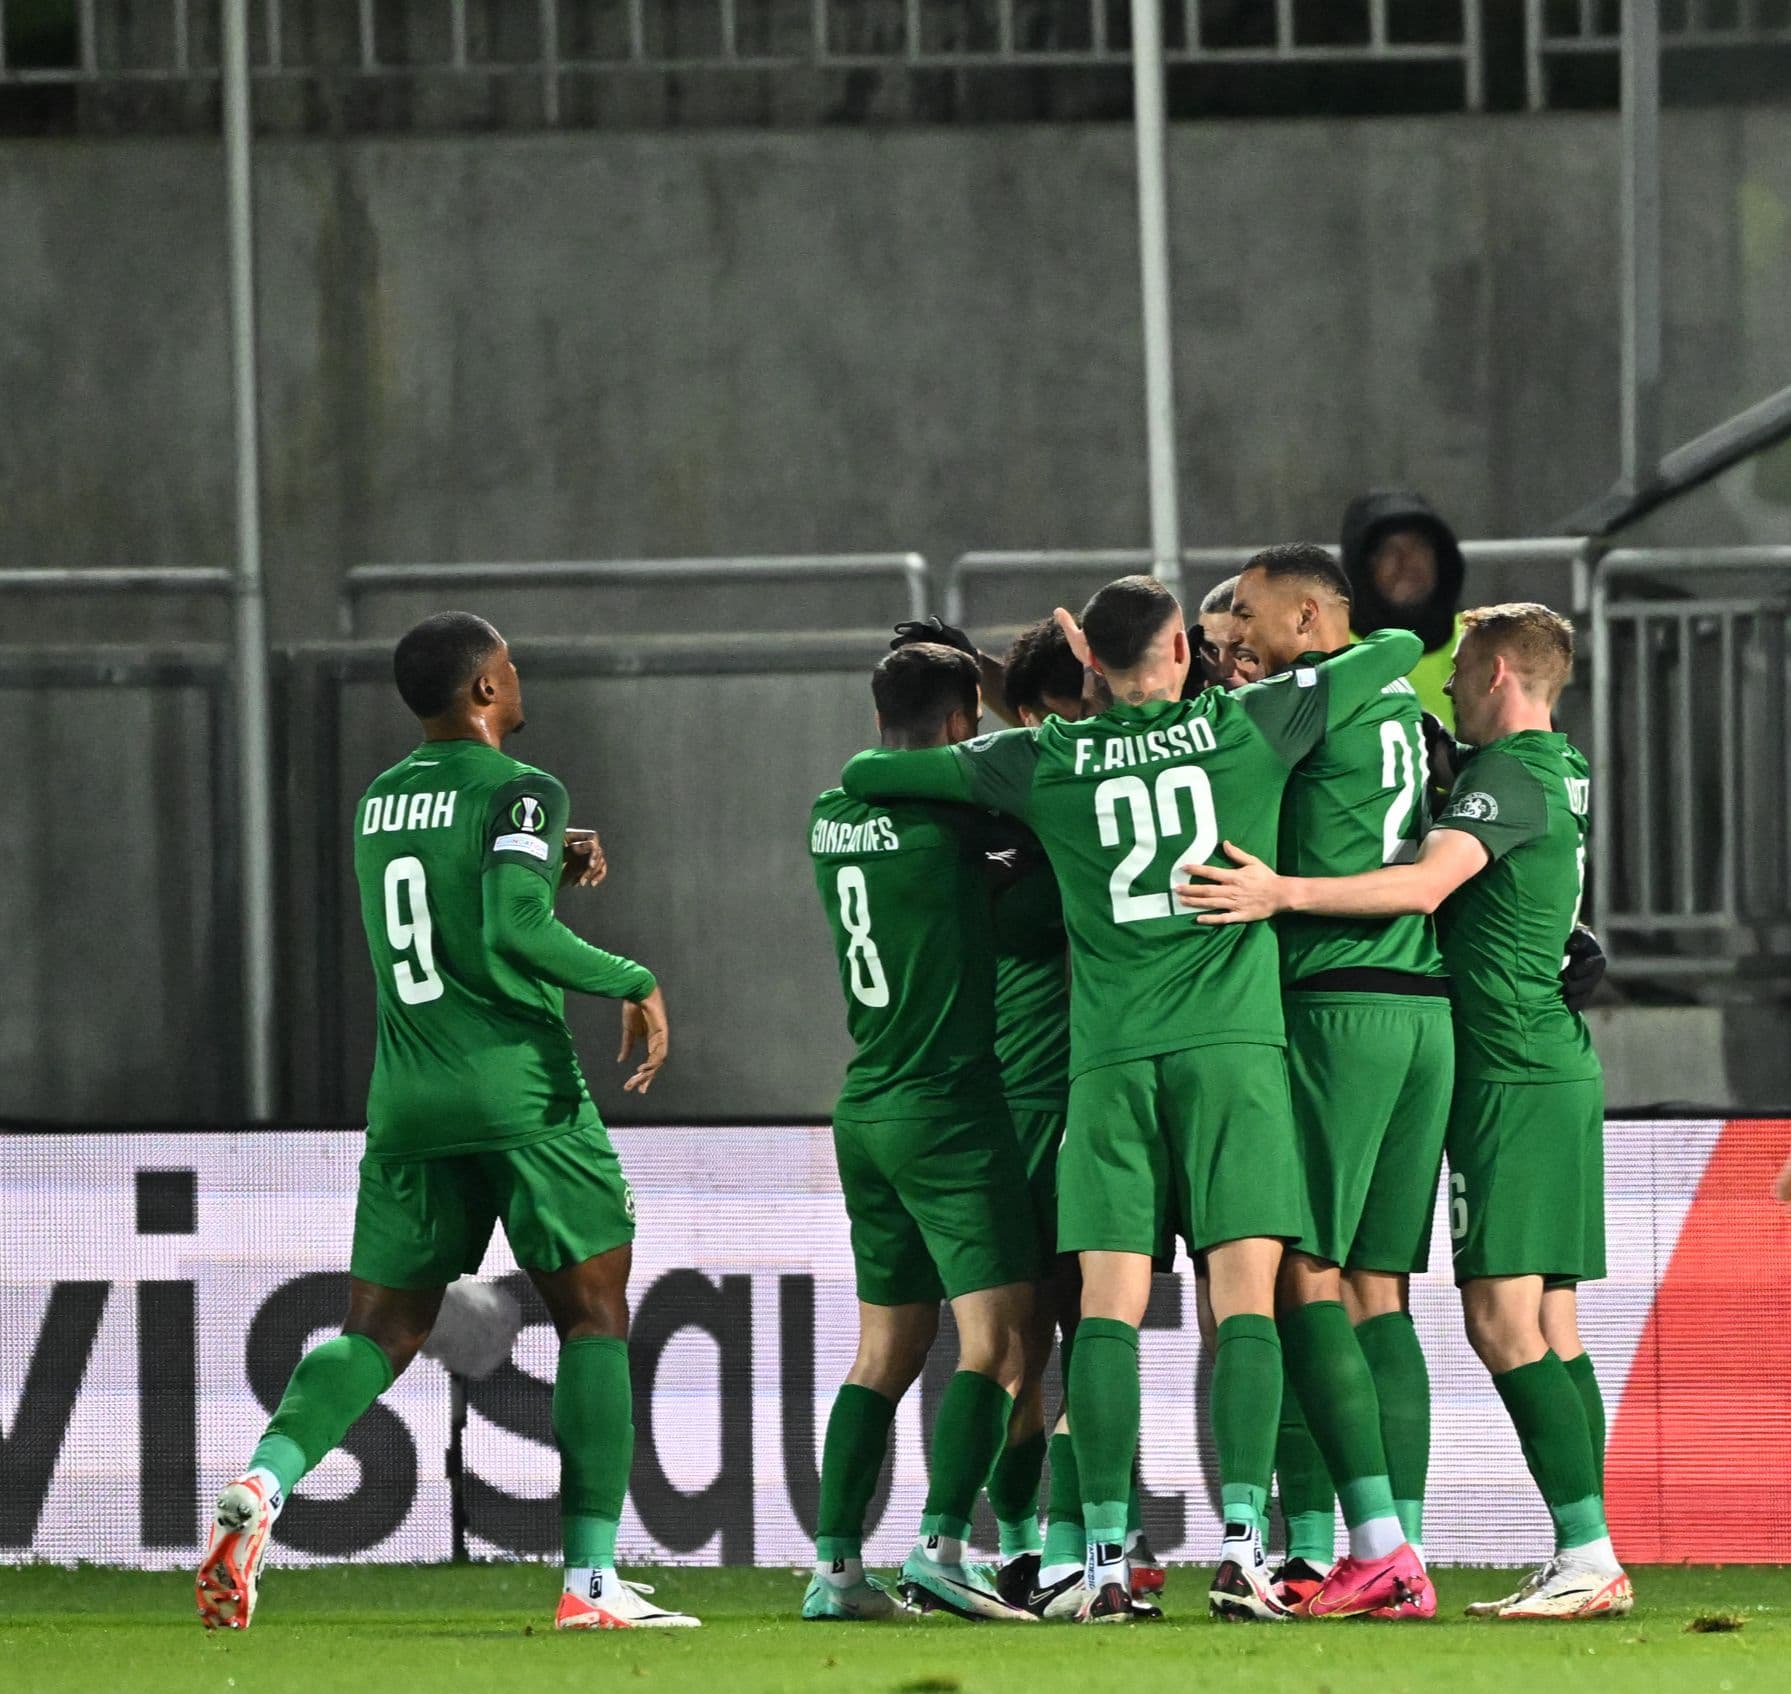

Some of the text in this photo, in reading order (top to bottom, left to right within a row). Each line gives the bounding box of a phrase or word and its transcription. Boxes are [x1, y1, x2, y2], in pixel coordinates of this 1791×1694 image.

[363, 791, 457, 835] DUAH
[1094, 765, 1218, 923] 22
[384, 856, 444, 1004] 9
[837, 866, 890, 1007] 8
